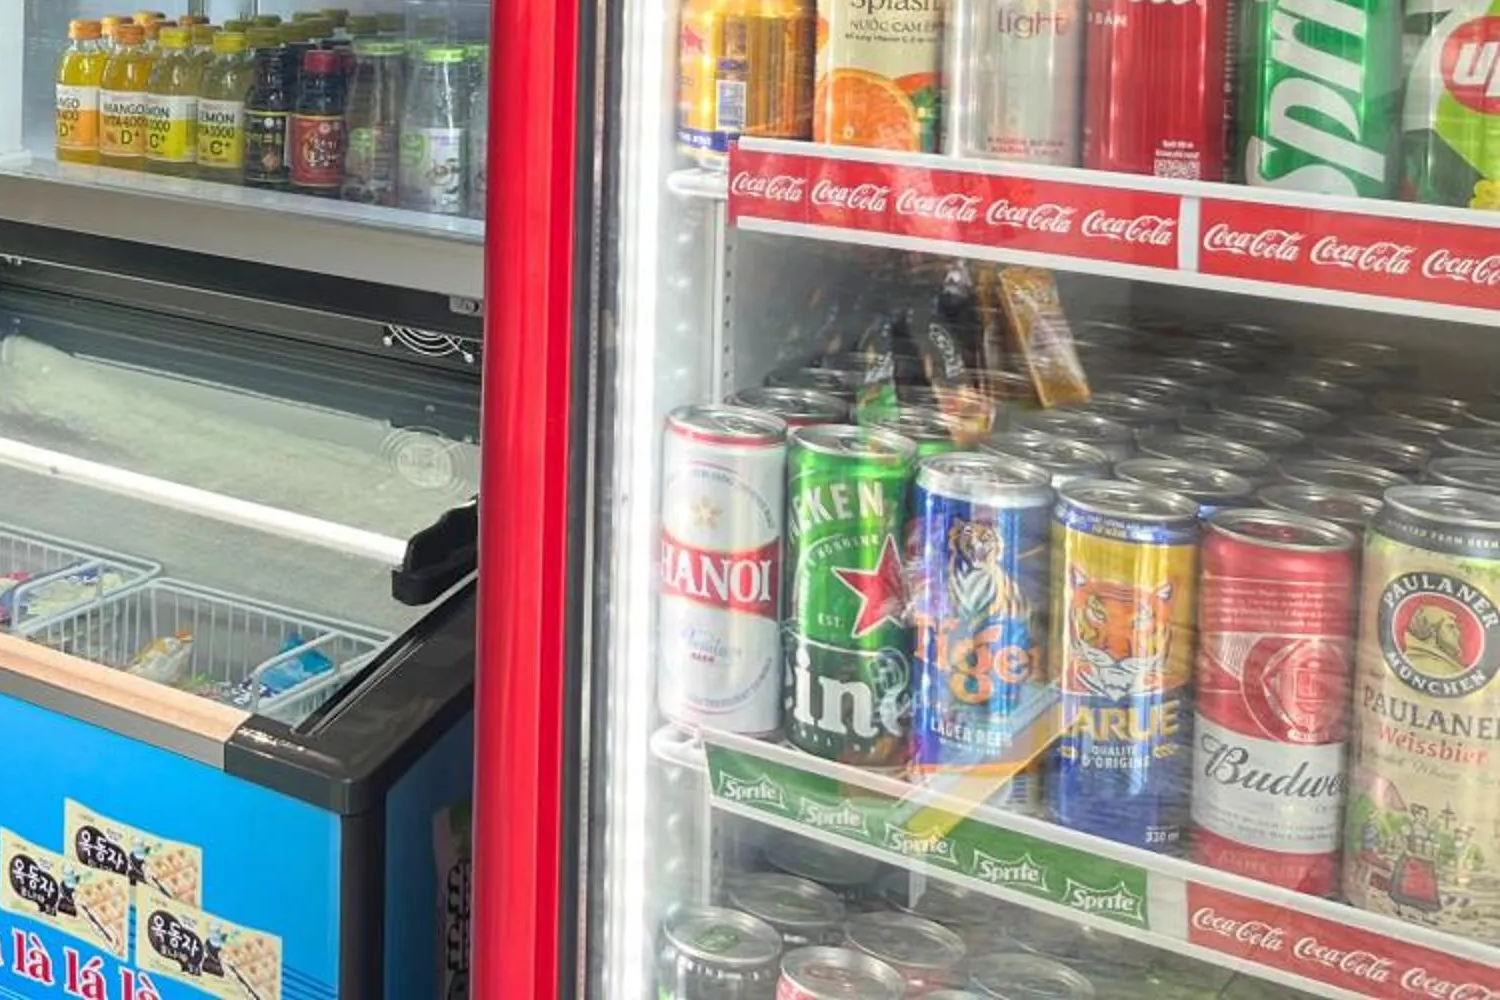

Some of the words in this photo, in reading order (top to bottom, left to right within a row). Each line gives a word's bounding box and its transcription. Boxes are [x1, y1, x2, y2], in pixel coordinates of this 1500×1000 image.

[995, 7, 1070, 39] light
[1383, 573, 1500, 630] PAULANER
[1362, 684, 1500, 741] PAULANE
[1379, 722, 1491, 768] Weissbier
[721, 777, 777, 805] Sprite
[805, 803, 863, 829] Sprite
[889, 829, 950, 857] Sprite
[978, 857, 1039, 885] Sprite
[1069, 886, 1135, 915] Sprite
[11, 927, 56, 986] là
[63, 948, 109, 1000] lá
